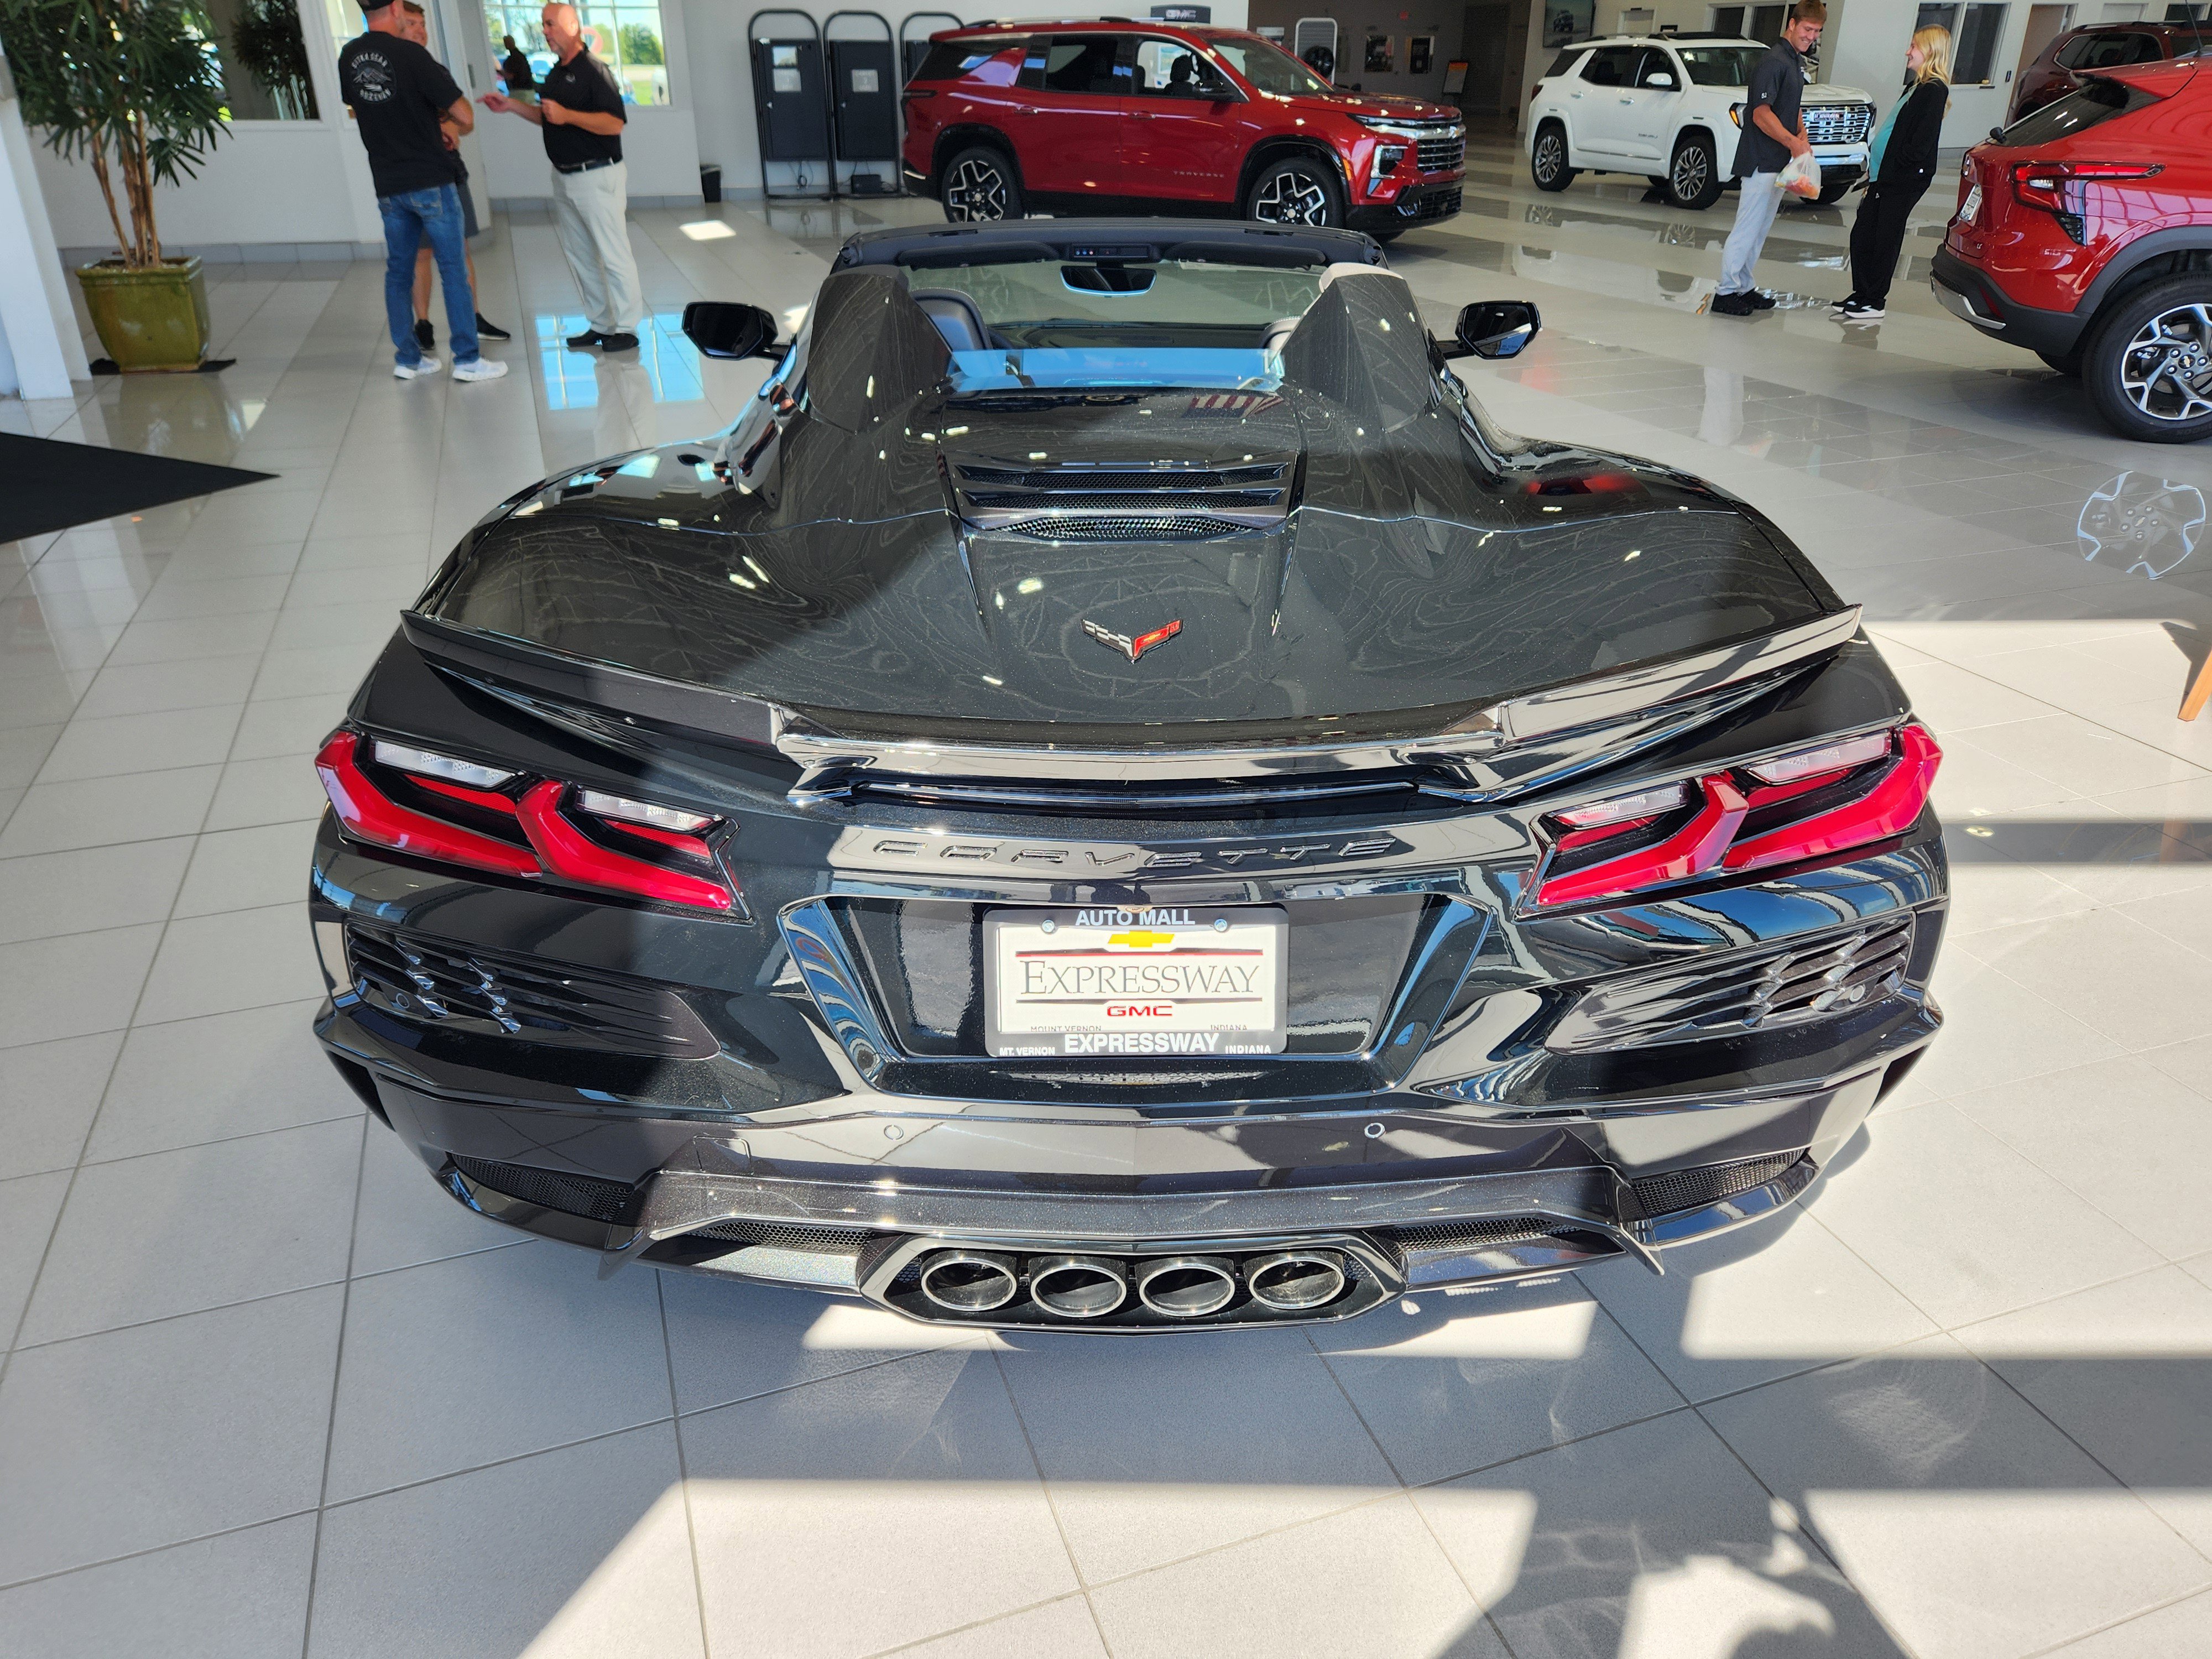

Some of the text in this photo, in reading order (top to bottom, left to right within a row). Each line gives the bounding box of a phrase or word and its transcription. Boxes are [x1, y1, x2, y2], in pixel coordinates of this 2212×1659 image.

[1165, 9, 1196, 20] GMC
[873, 837, 1396, 868] CORVETTE
[1076, 909, 1196, 926] AUTO MALL
[1019, 960, 1260, 995] EXPRESSWAY
[1107, 1005, 1173, 1017] GMC
[999, 1032, 1271, 1056] MT. VERNON EXPRESSWAY INDIANA
